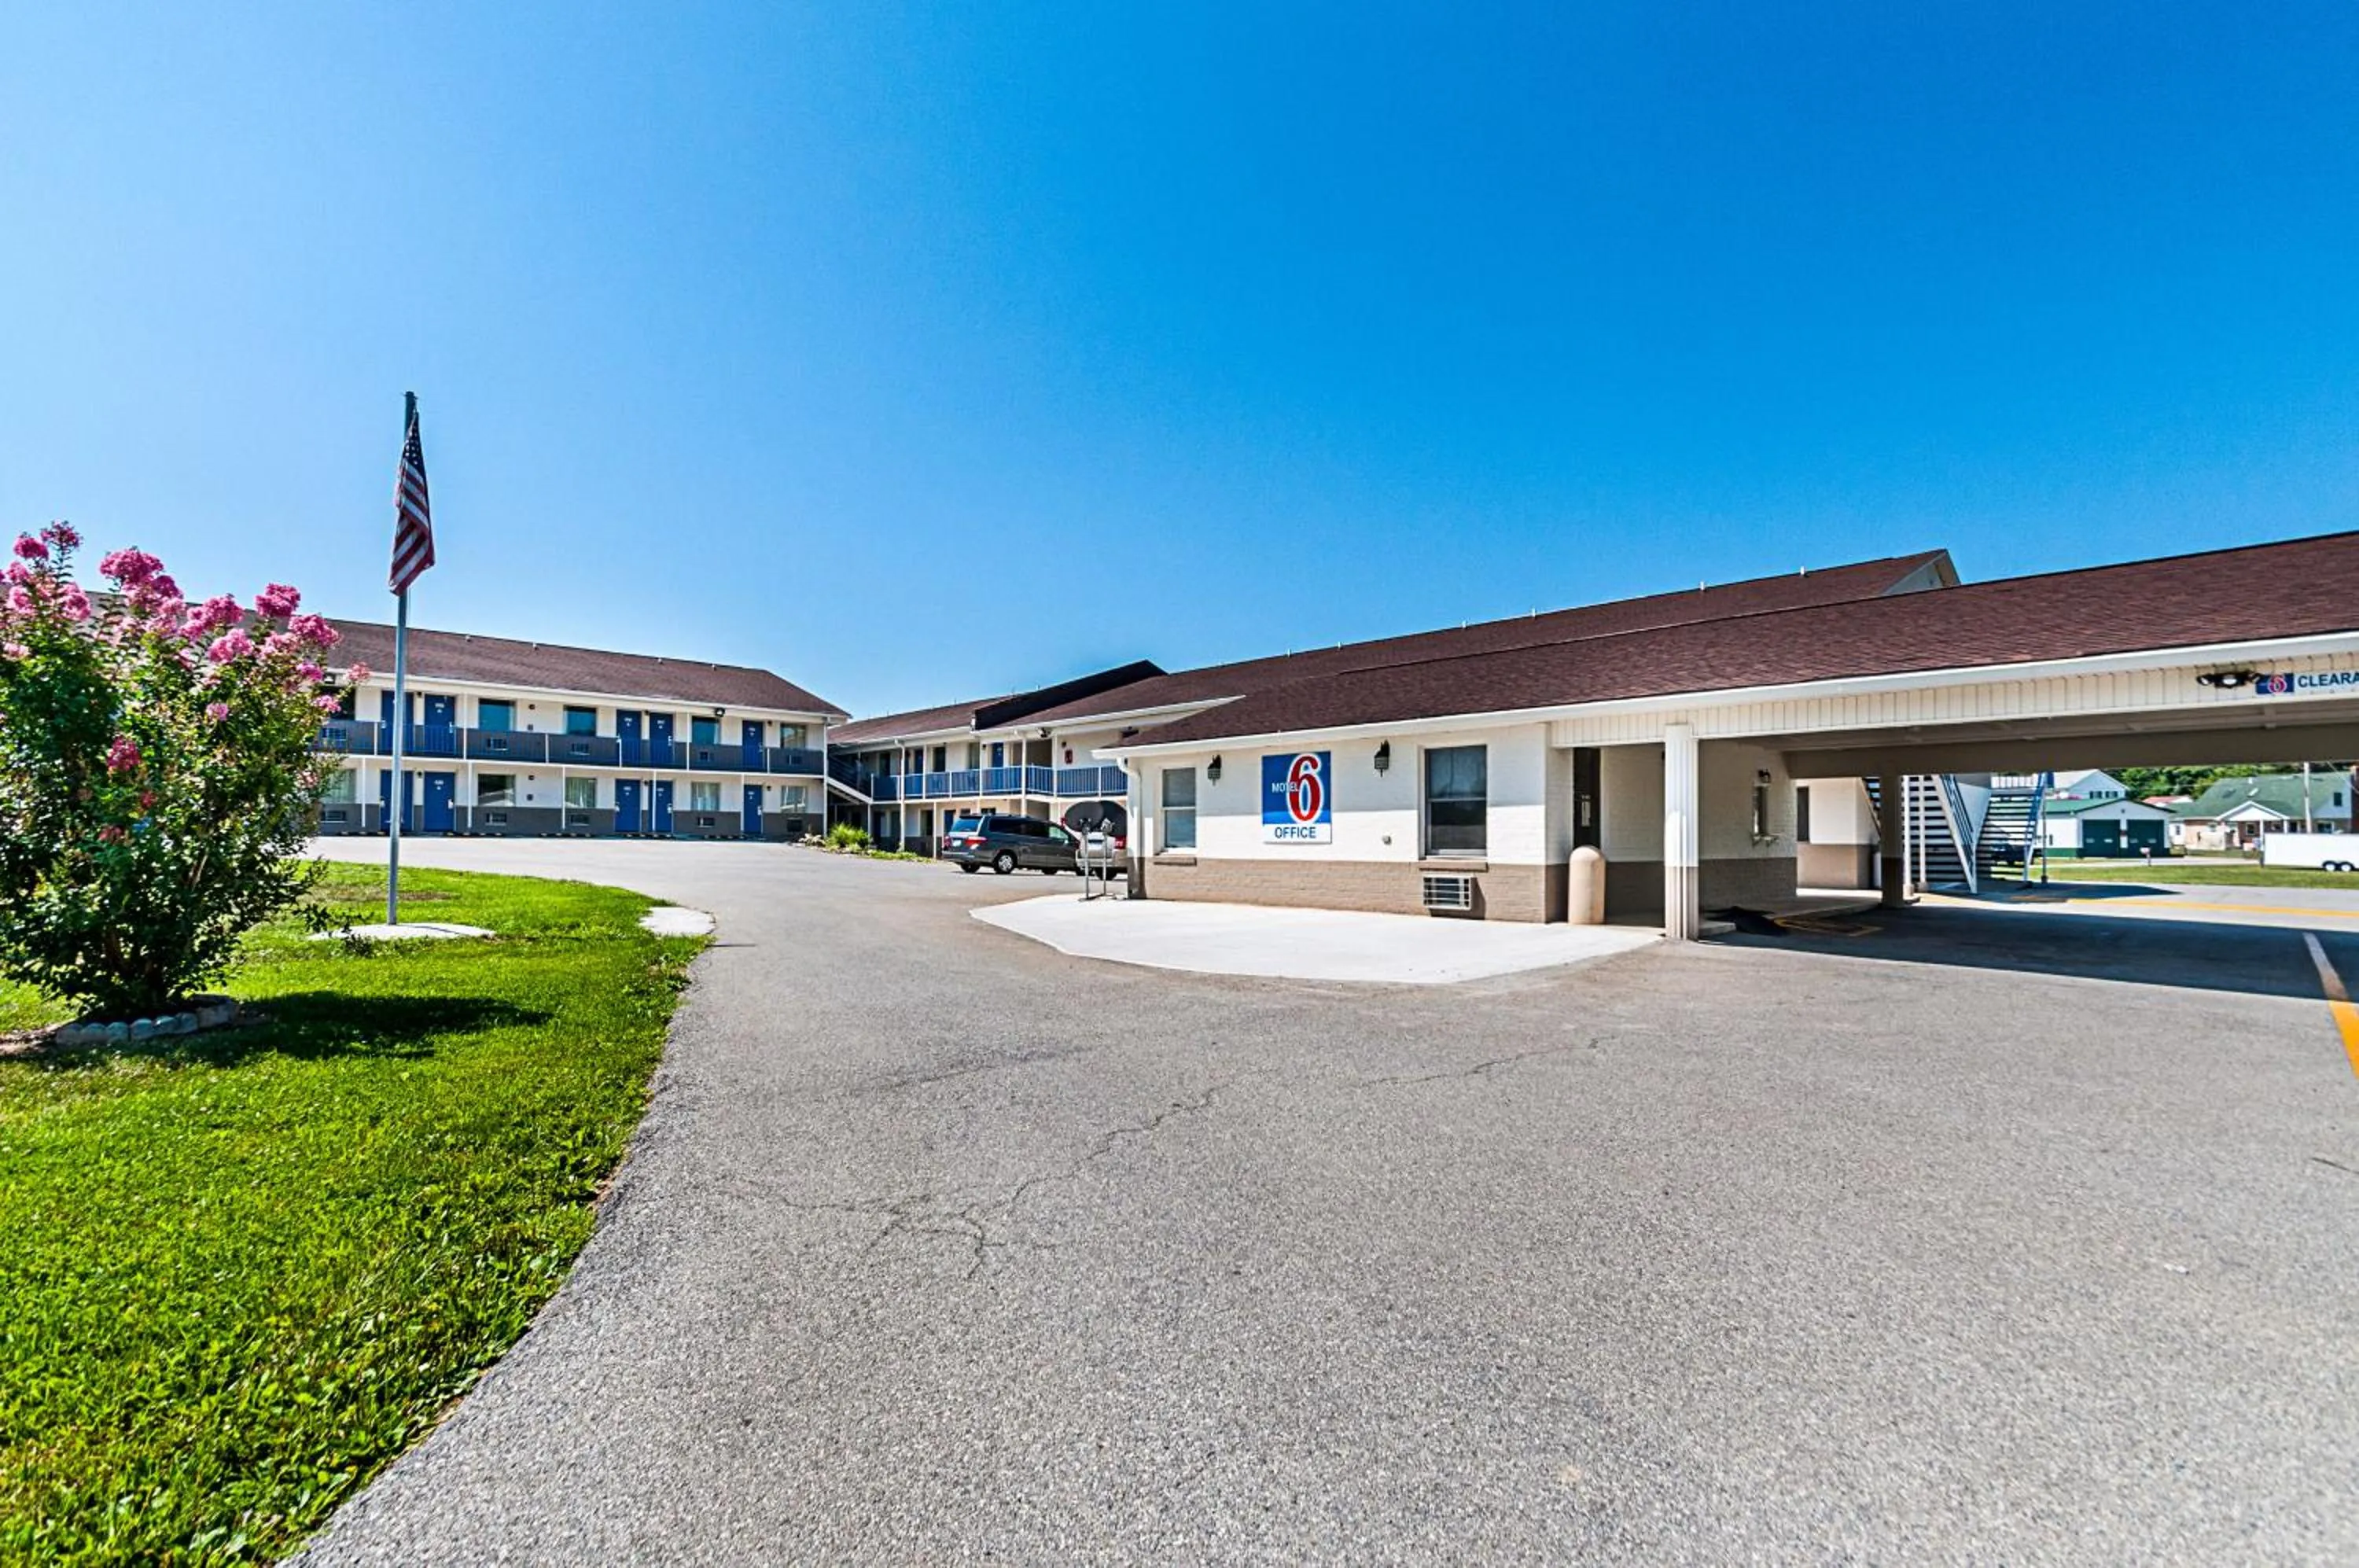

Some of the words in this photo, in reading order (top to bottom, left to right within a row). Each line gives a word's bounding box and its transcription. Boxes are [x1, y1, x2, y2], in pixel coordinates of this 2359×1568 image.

[2298, 672, 2359, 688] CLEARA
[1272, 782, 1300, 793] MOTEL
[1287, 754, 1323, 823] 6
[1274, 826, 1316, 839] OFFICE
